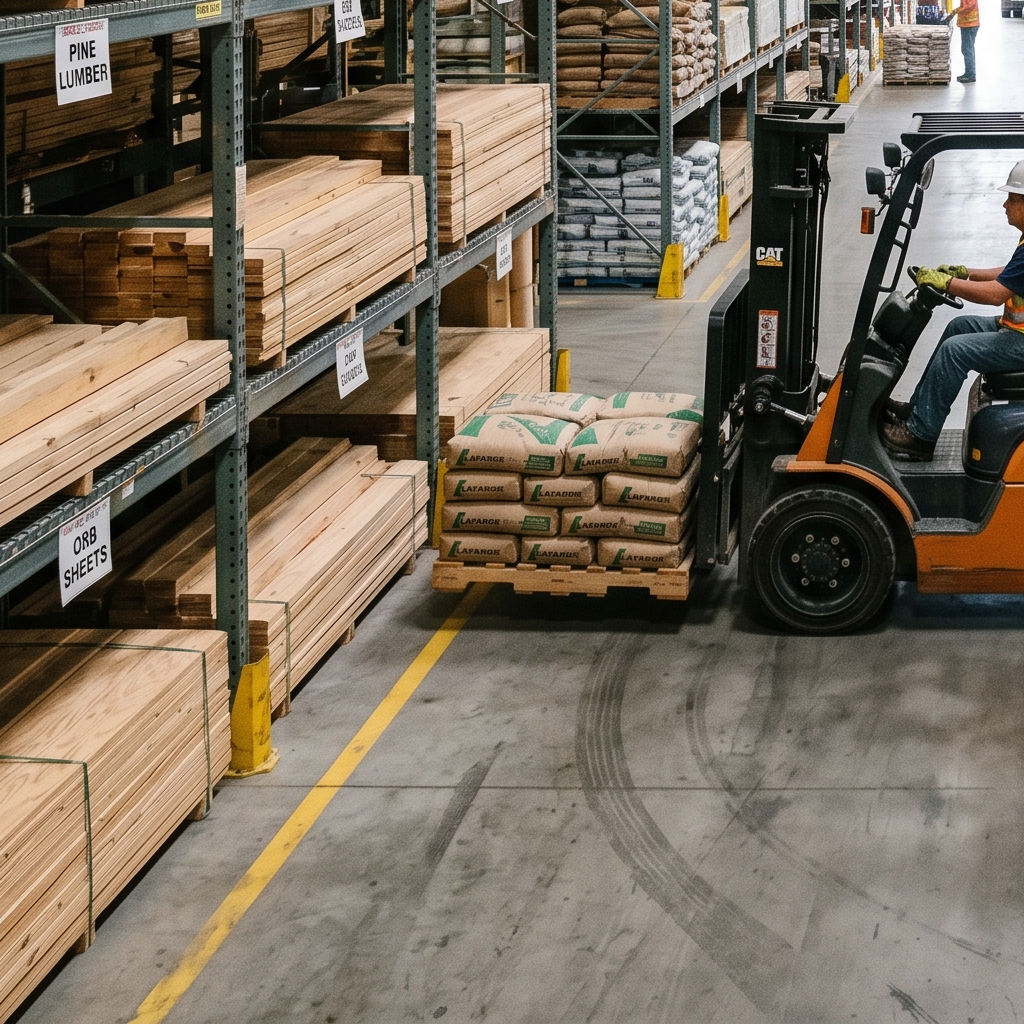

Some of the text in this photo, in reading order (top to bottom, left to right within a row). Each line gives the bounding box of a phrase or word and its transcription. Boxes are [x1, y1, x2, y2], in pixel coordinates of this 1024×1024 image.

[69, 40, 96, 62] PINE
[59, 63, 108, 90] LUMBER
[755, 246, 784, 262] CAT
[73, 526, 97, 555] ORB
[63, 544, 108, 589] SHEETS
